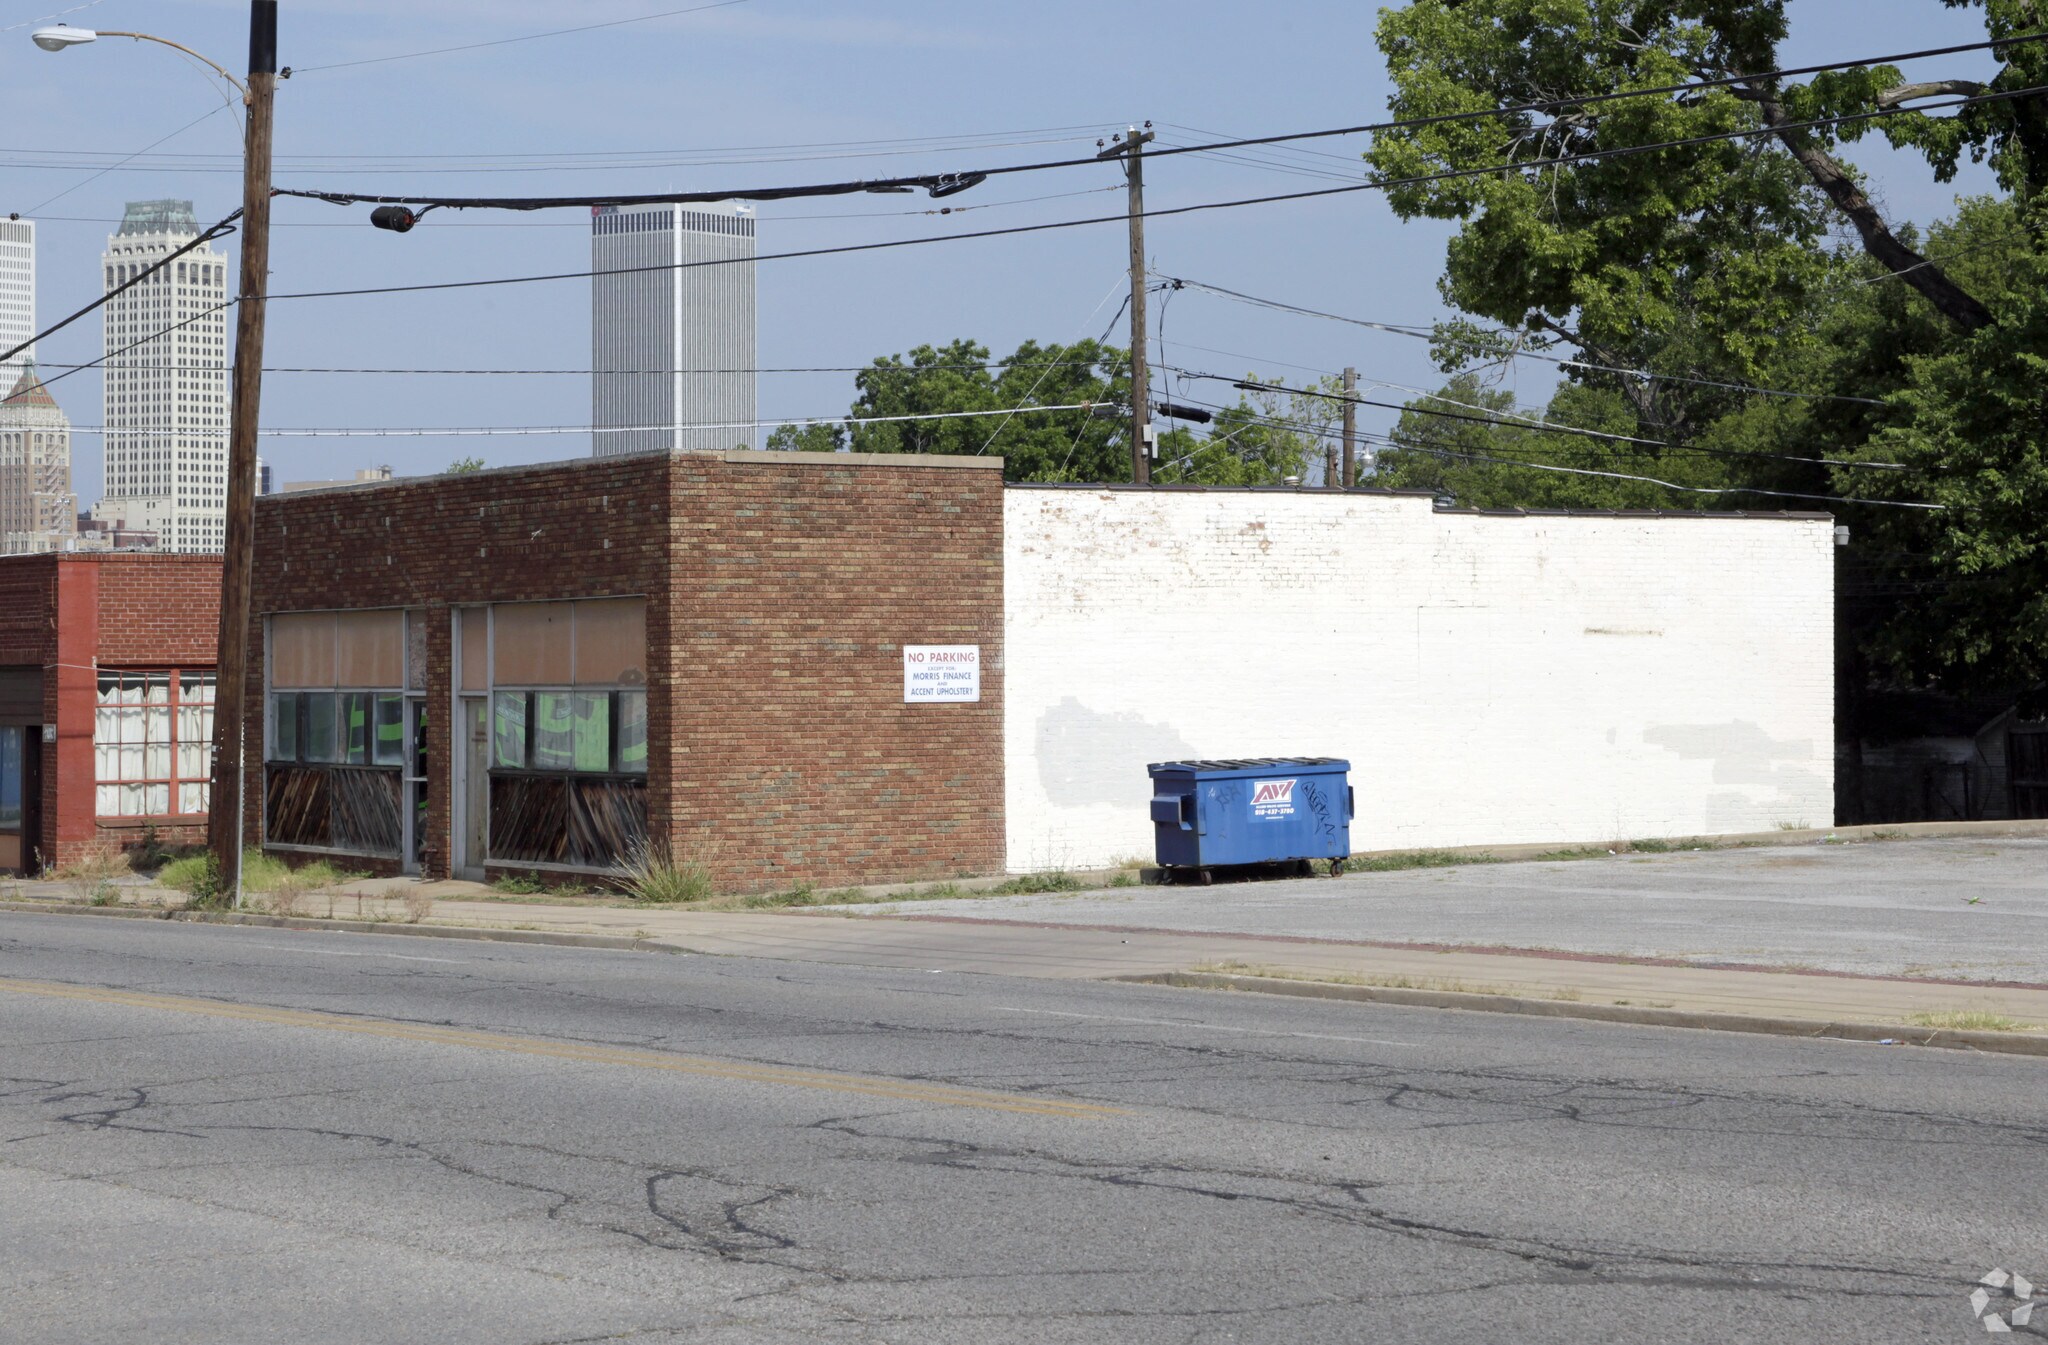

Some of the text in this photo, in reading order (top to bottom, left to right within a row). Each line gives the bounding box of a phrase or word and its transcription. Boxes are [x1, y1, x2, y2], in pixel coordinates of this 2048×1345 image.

[908, 652, 975, 663] NO PARKING
[912, 672, 972, 681] MORRIS FINANCE
[936, 687, 973, 695] UPHOLSTERY
